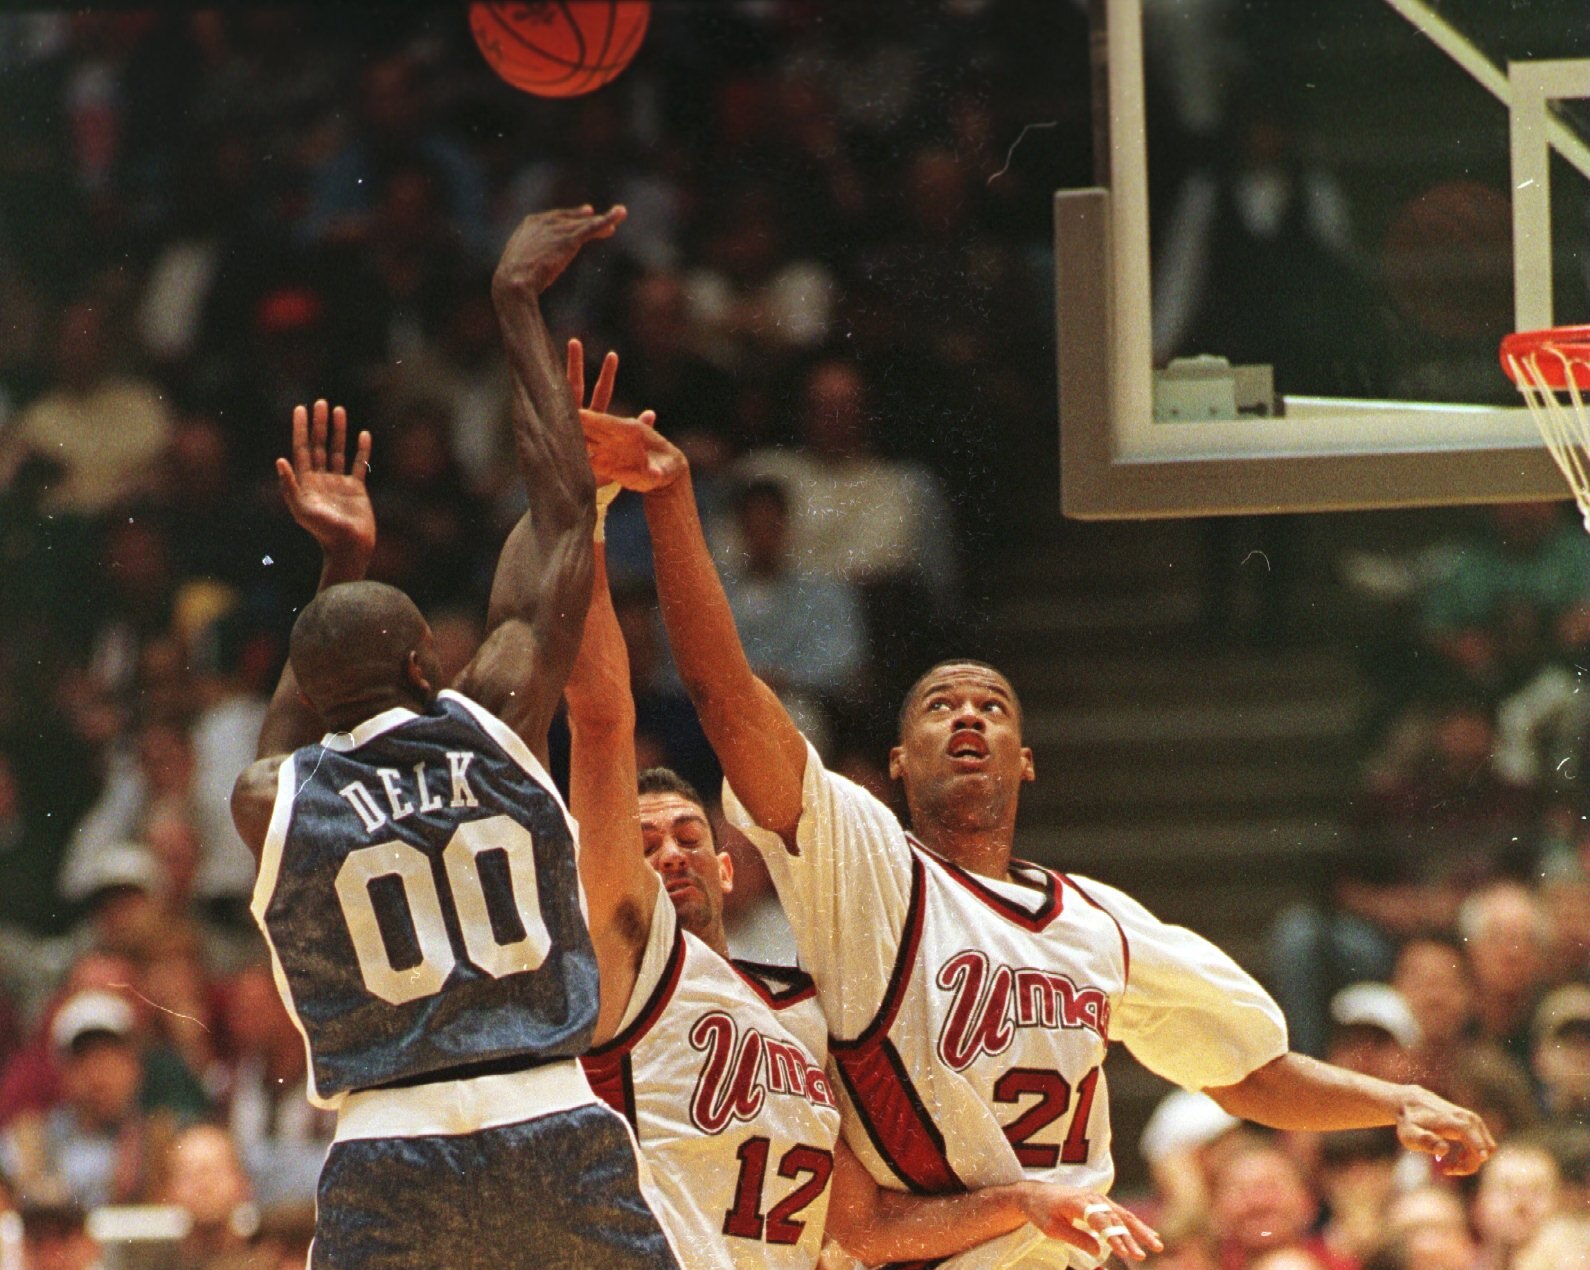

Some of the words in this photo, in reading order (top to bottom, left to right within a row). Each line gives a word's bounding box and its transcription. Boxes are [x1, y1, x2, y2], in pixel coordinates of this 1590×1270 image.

[338, 751, 479, 834] DELK
[334, 814, 552, 1007] 00
[936, 949, 1110, 1072] Uma
[992, 1065, 1090, 1169] 21
[722, 1134, 835, 1246] 12
